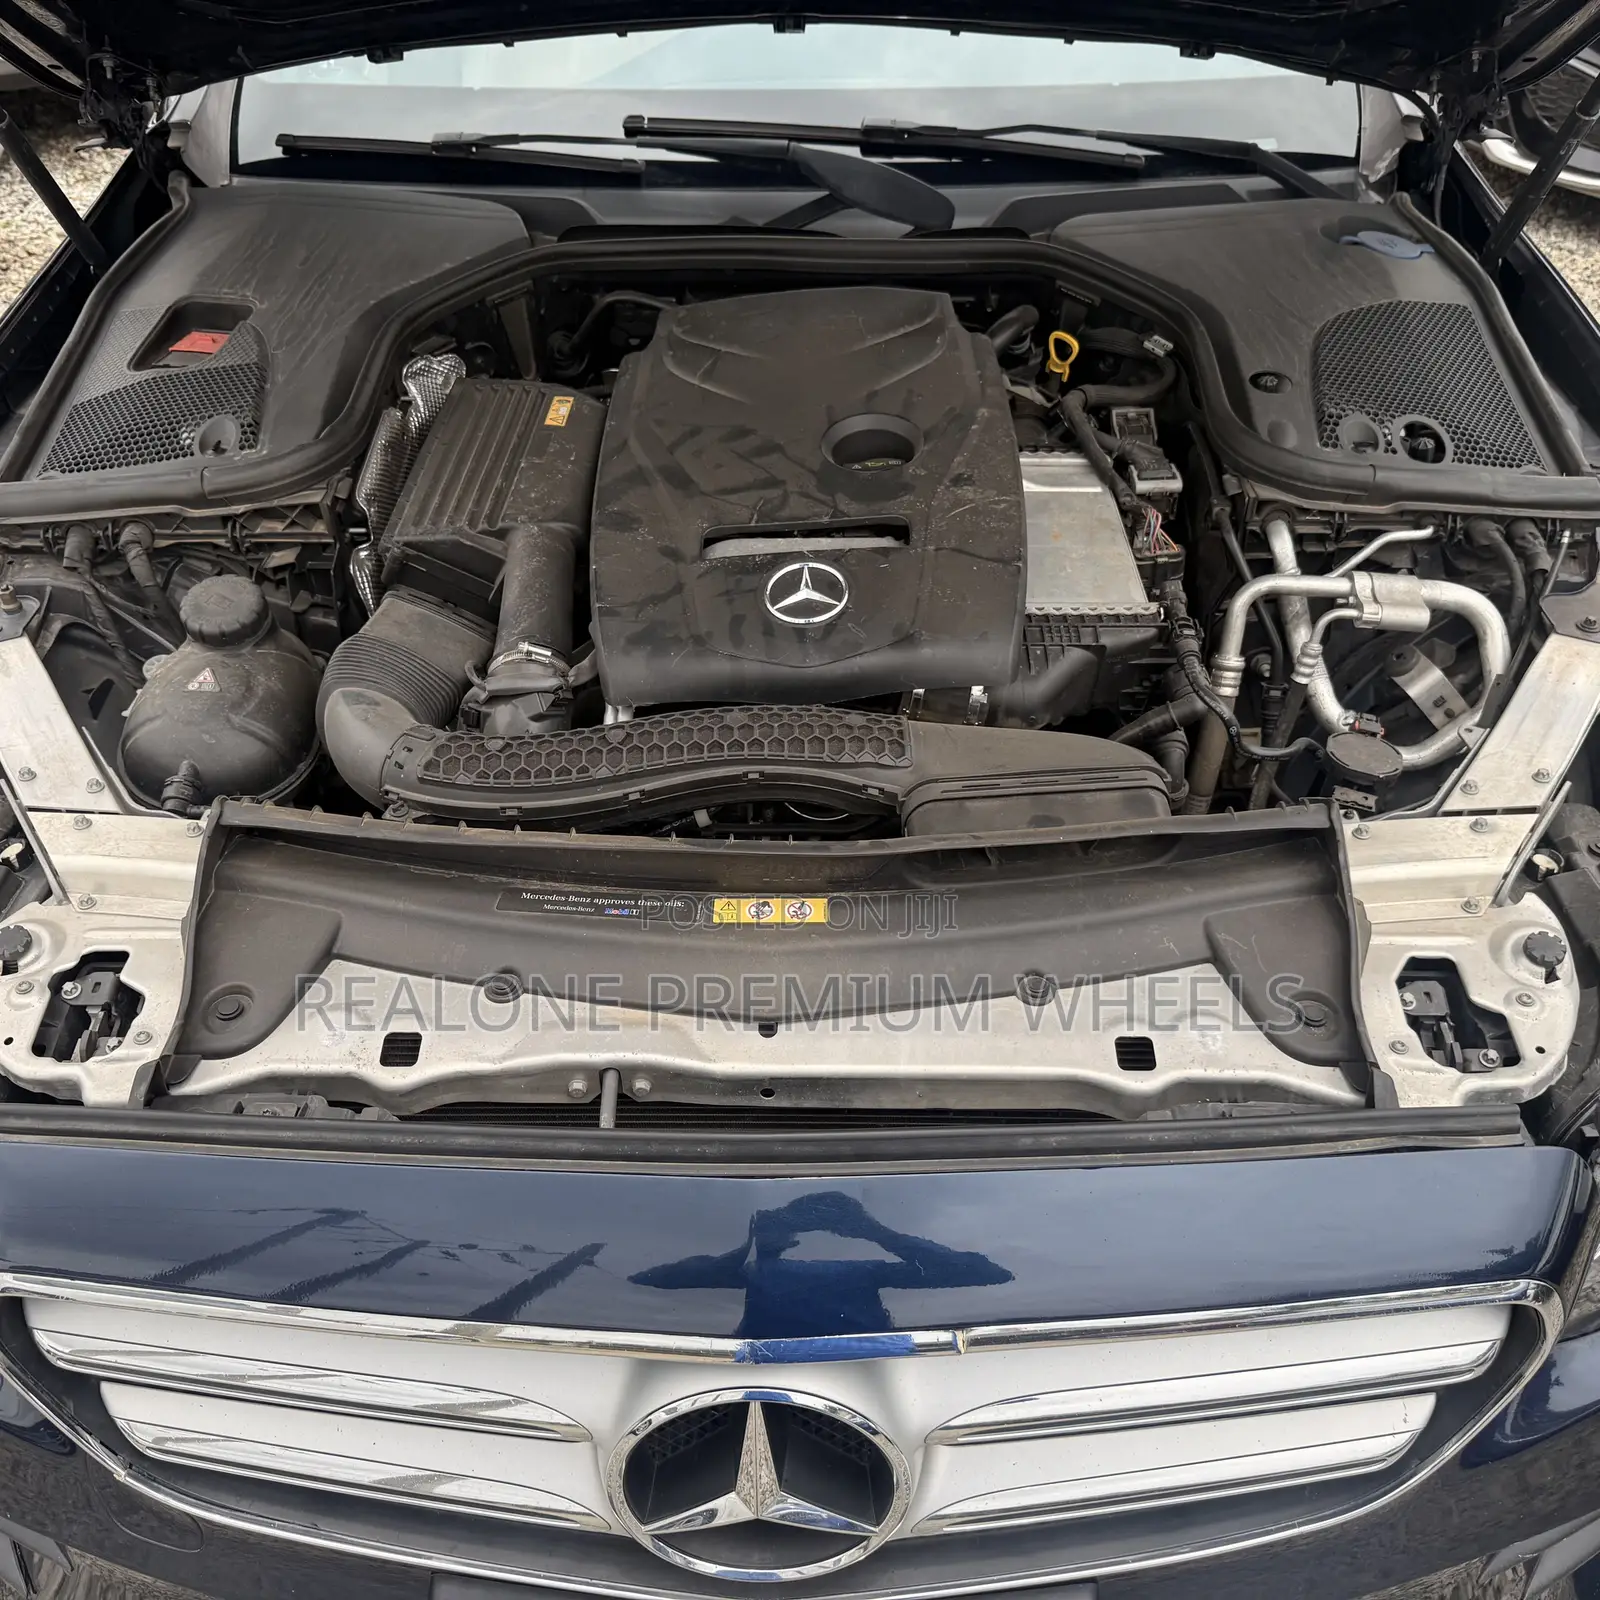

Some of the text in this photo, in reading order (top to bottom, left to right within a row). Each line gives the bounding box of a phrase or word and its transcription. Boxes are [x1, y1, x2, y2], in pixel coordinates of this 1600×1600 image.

[520, 892, 591, 903] Mercedes-Benz
[593, 897, 635, 906] approves
[637, 898, 663, 907] these
